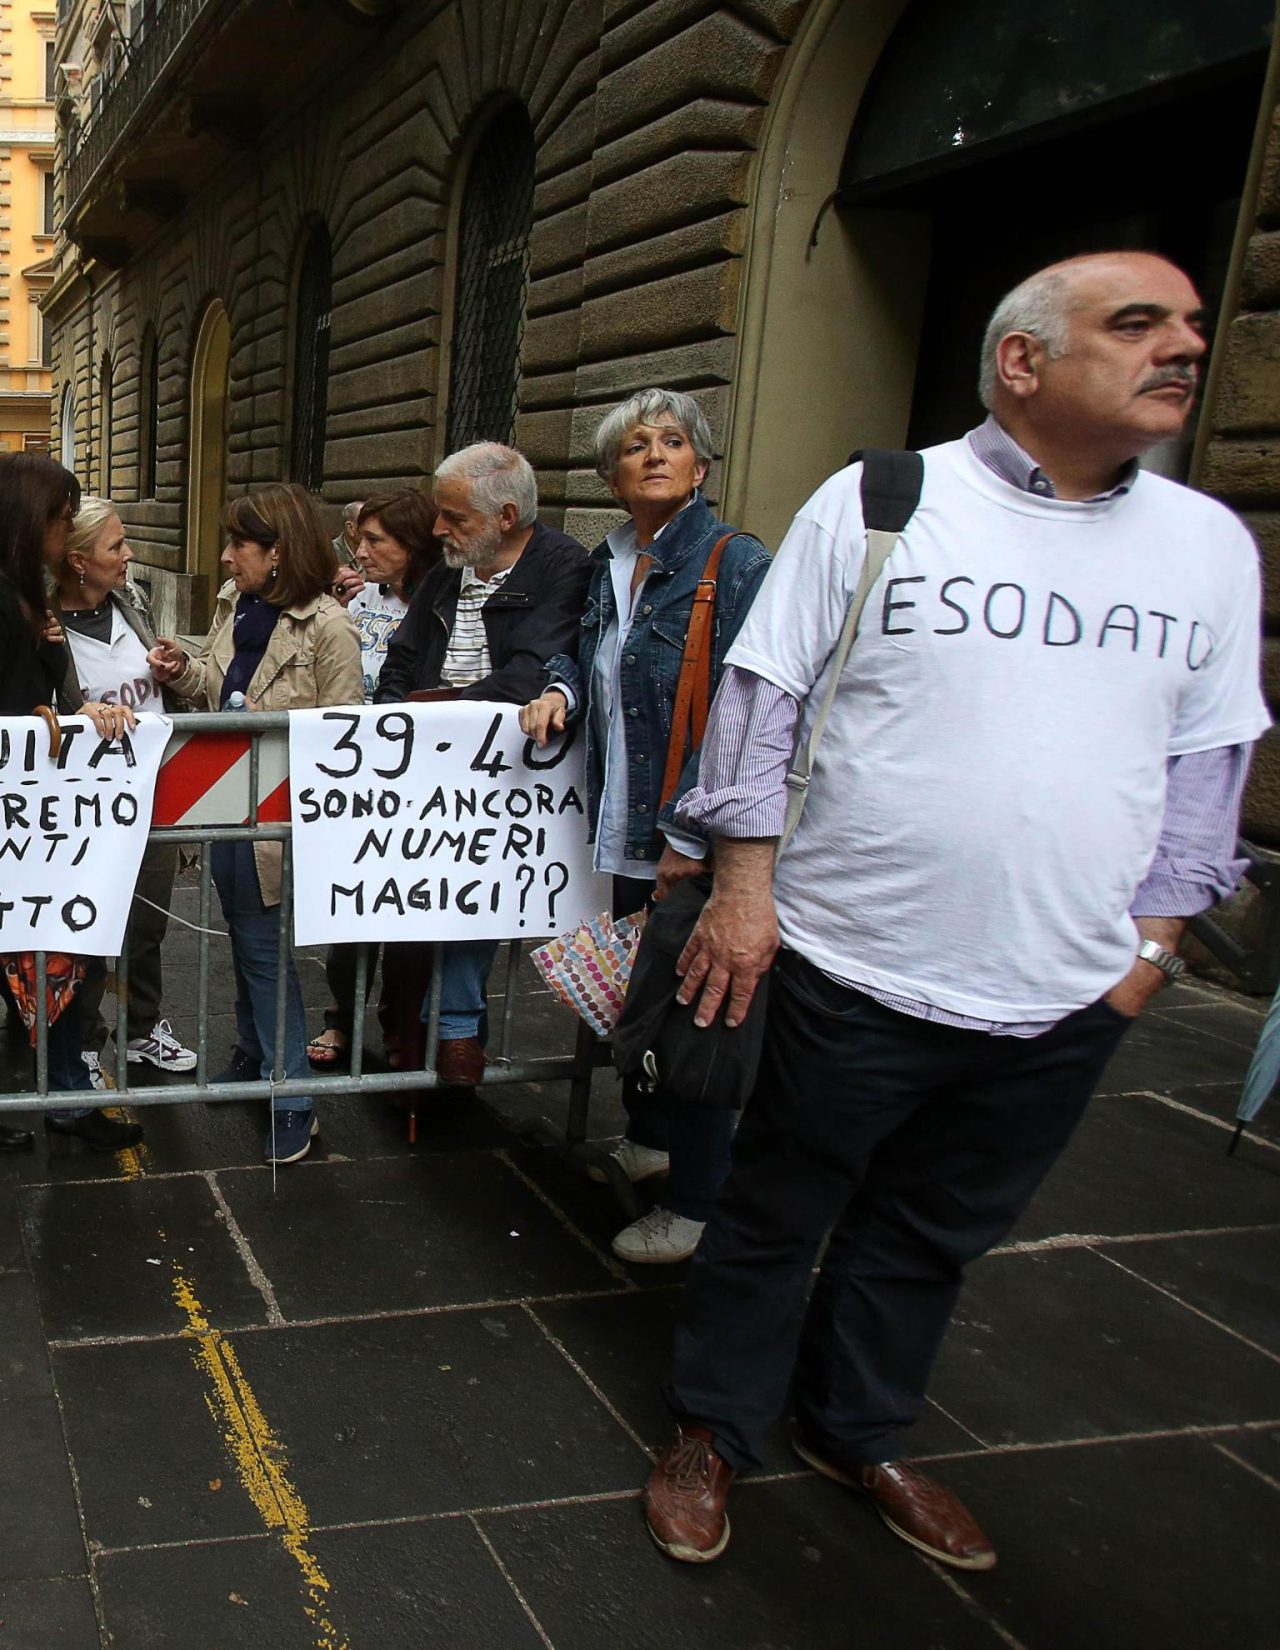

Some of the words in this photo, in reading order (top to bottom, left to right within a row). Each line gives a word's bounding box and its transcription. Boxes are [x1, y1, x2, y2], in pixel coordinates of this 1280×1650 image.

[881, 575, 1216, 671] ESODATO
[419, 783, 585, 822] ANCORA
[353, 823, 547, 865] NUMERI
